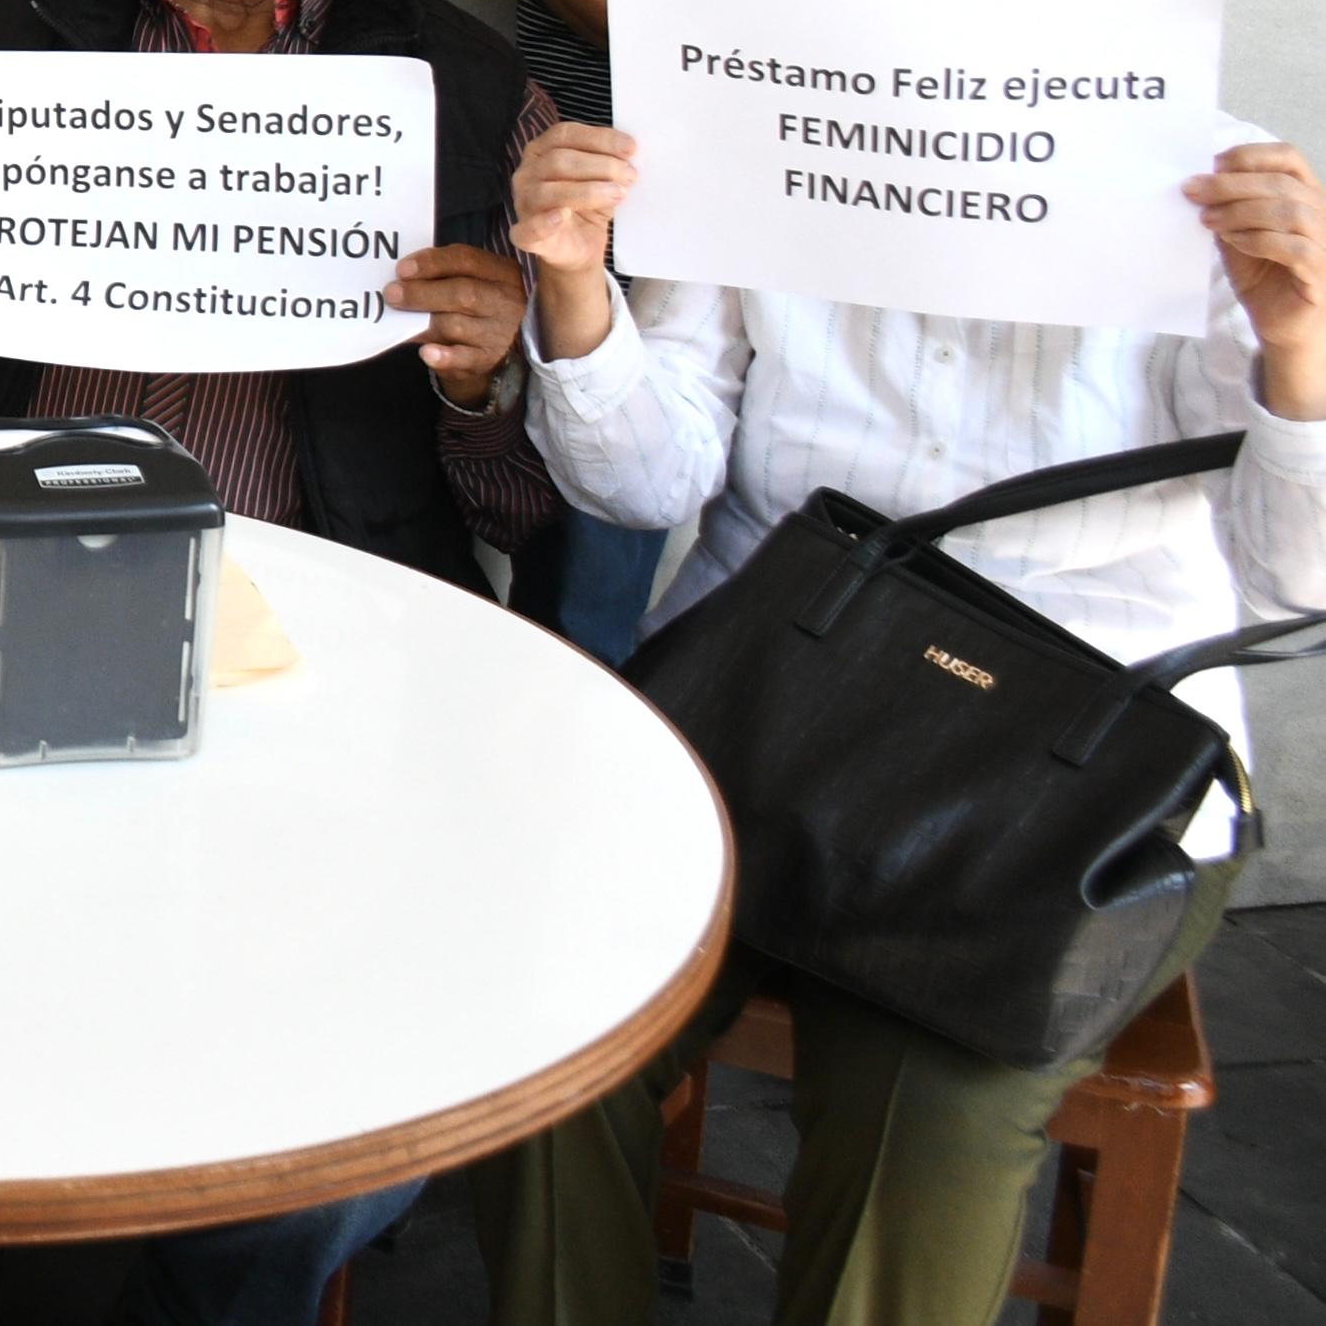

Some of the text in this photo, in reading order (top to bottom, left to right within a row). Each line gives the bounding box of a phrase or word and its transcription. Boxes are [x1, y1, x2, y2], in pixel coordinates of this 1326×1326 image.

[681, 44, 1166, 108] Préstamo Feliz ejecuta
[164, 110, 185, 140] y
[196, 103, 403, 144] Senadores,
[778, 113, 1055, 163] FEMINICIDIO
[188, 168, 207, 191] a
[219, 162, 382, 203] trabajar!
[785, 169, 1049, 224] FINANCIERO
[172, 222, 219, 253] MI
[233, 221, 399, 261] PENSIÓN
[70, 280, 92, 307] 4
[104, 279, 386, 324] Constitucional)
[924, 644, 993, 689] HUSER
